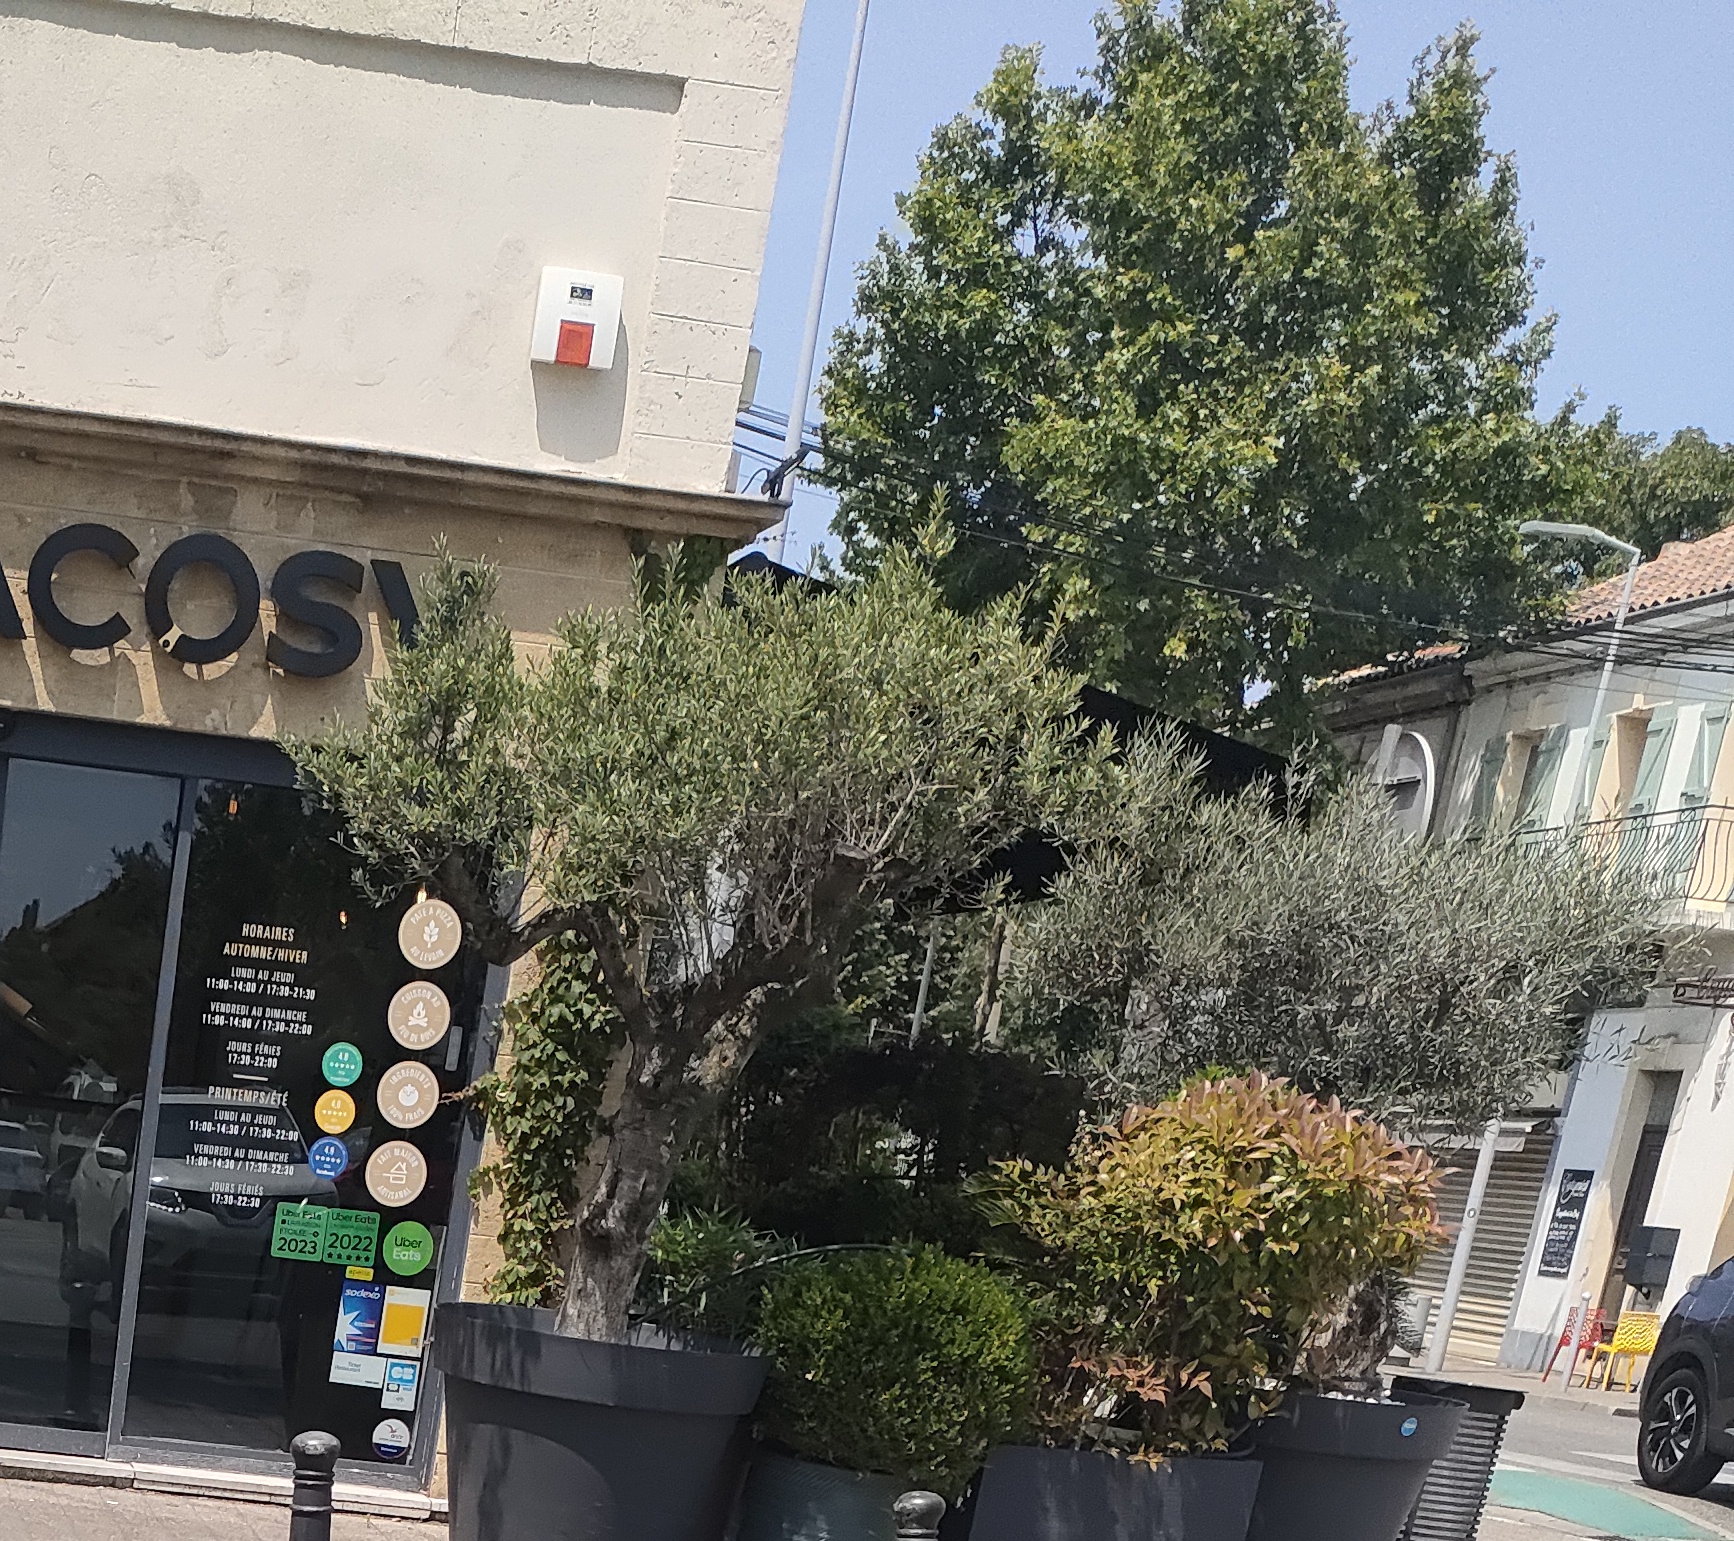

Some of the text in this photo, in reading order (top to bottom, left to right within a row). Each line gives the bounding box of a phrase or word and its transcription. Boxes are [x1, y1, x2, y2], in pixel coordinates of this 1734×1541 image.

[436, 908, 454, 929] PIZZA
[242, 923, 295, 942] HORAIRES
[223, 942, 308, 964] AUTOMNE/HIVER
[420, 948, 445, 962] LEVAIN
[231, 966, 295, 984] LUNDI AU JEUDI
[206, 978, 257, 993] 11:00-14:00
[266, 984, 316, 1000] 17:30-21:30
[401, 988, 441, 1008] CUISSON AU
[210, 1001, 307, 1022] VENDREDI AU DIMANCHE
[202, 1013, 252, 1029] 11:00-14:00
[262, 1020, 312, 1035] 17:30-22:00
[398, 1024, 436, 1043] FEU DE BOIS
[226, 1041, 252, 1054] JOURS
[228, 1053, 278, 1069] 17:30-22:00
[208, 1085, 289, 1106] PRINTEMPS/ÉTÉ
[214, 1109, 277, 1126] LUNDI AU JEUDI
[405, 1107, 425, 1122] FRAIS
[189, 1120, 239, 1135] 11:00-14:30
[249, 1126, 298, 1142] 17:30-22:00
[194, 1143, 289, 1163] VENDREDI AU DIMANCHE
[376, 1148, 419, 1168] FAIT MAISON
[186, 1155, 235, 1170] 11:00-14:30
[245, 1161, 294, 1176] 17:30-22:30
[210, 1181, 264, 1196] JOURS FÉRIÉS
[377, 1185, 412, 1200] ARTISANAL
[211, 1193, 261, 1208] 17:30-22:30
[331, 1212, 376, 1226] Uber Eats
[277, 1237, 317, 1255] 2023
[328, 1232, 373, 1252] 2022
[395, 1235, 423, 1248] Uber
[393, 1248, 421, 1261] Eats
[345, 1287, 381, 1299] sodexo
